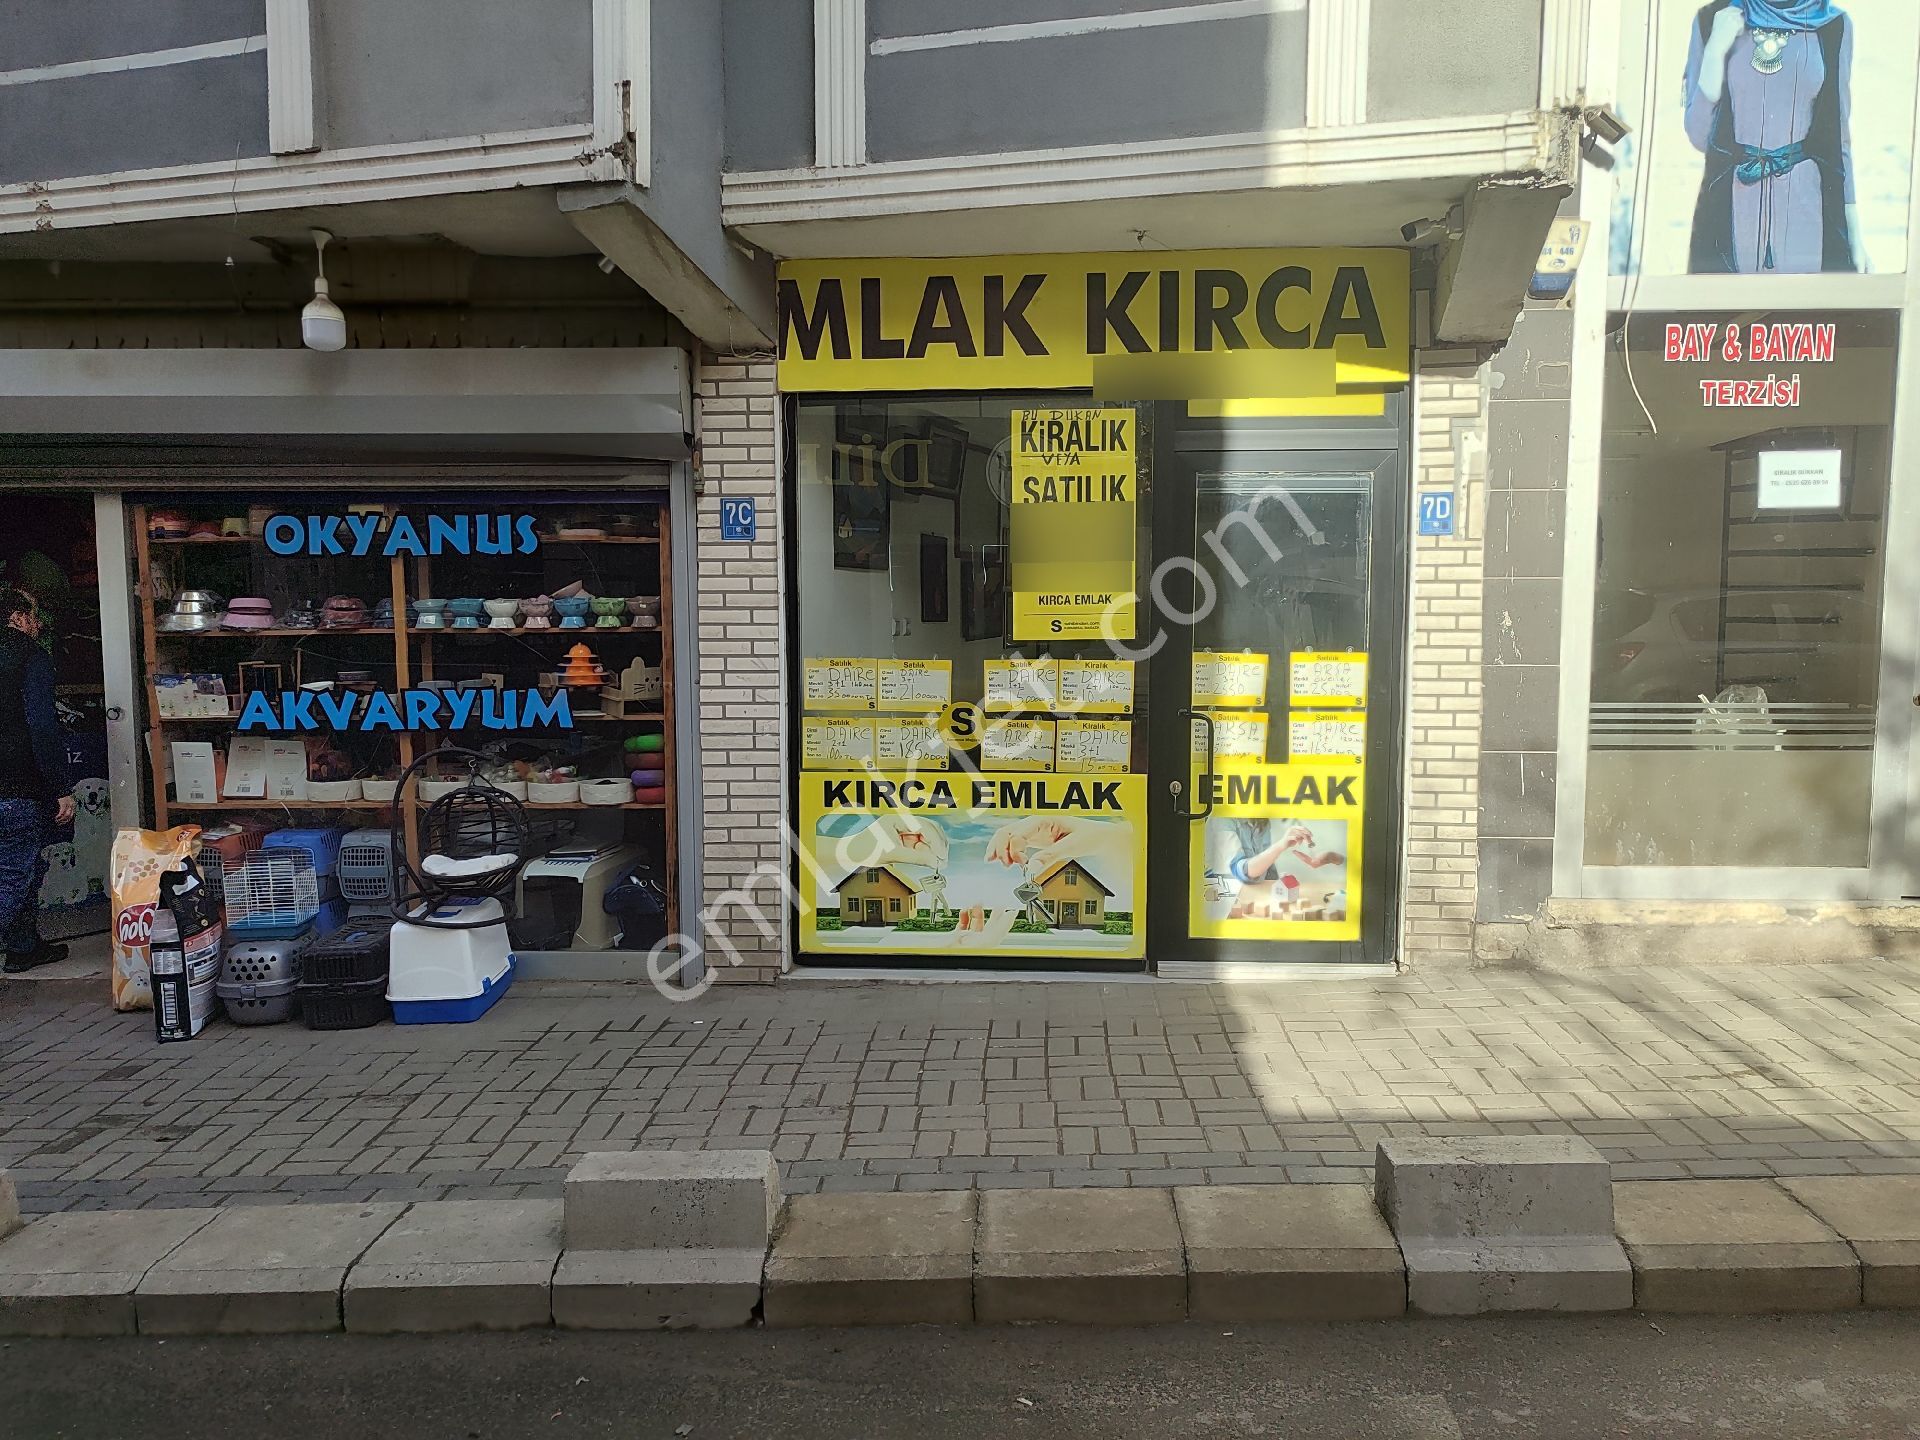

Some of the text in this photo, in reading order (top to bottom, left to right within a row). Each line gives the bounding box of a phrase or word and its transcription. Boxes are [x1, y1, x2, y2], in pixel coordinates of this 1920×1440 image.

[1085, 265, 1387, 355] KIRCA
[1665, 324, 1836, 363] BAY & BAYAN
[1700, 374, 1800, 407] TERZİSİ
[1041, 452, 1080, 465] VEYA
[1023, 475, 1127, 503] SATILIK
[726, 503, 751, 524] 7C
[1424, 497, 1450, 519] 7D
[265, 514, 538, 556] OKYANUS
[1038, 594, 1112, 605] KIRCA EMLAK
[1051, 620, 1062, 632] S
[238, 688, 573, 731] AKVARYUM
[951, 708, 975, 735] S
[823, 780, 1123, 811] KIRCA EMLAK
[1199, 775, 1358, 806] EMLAK
